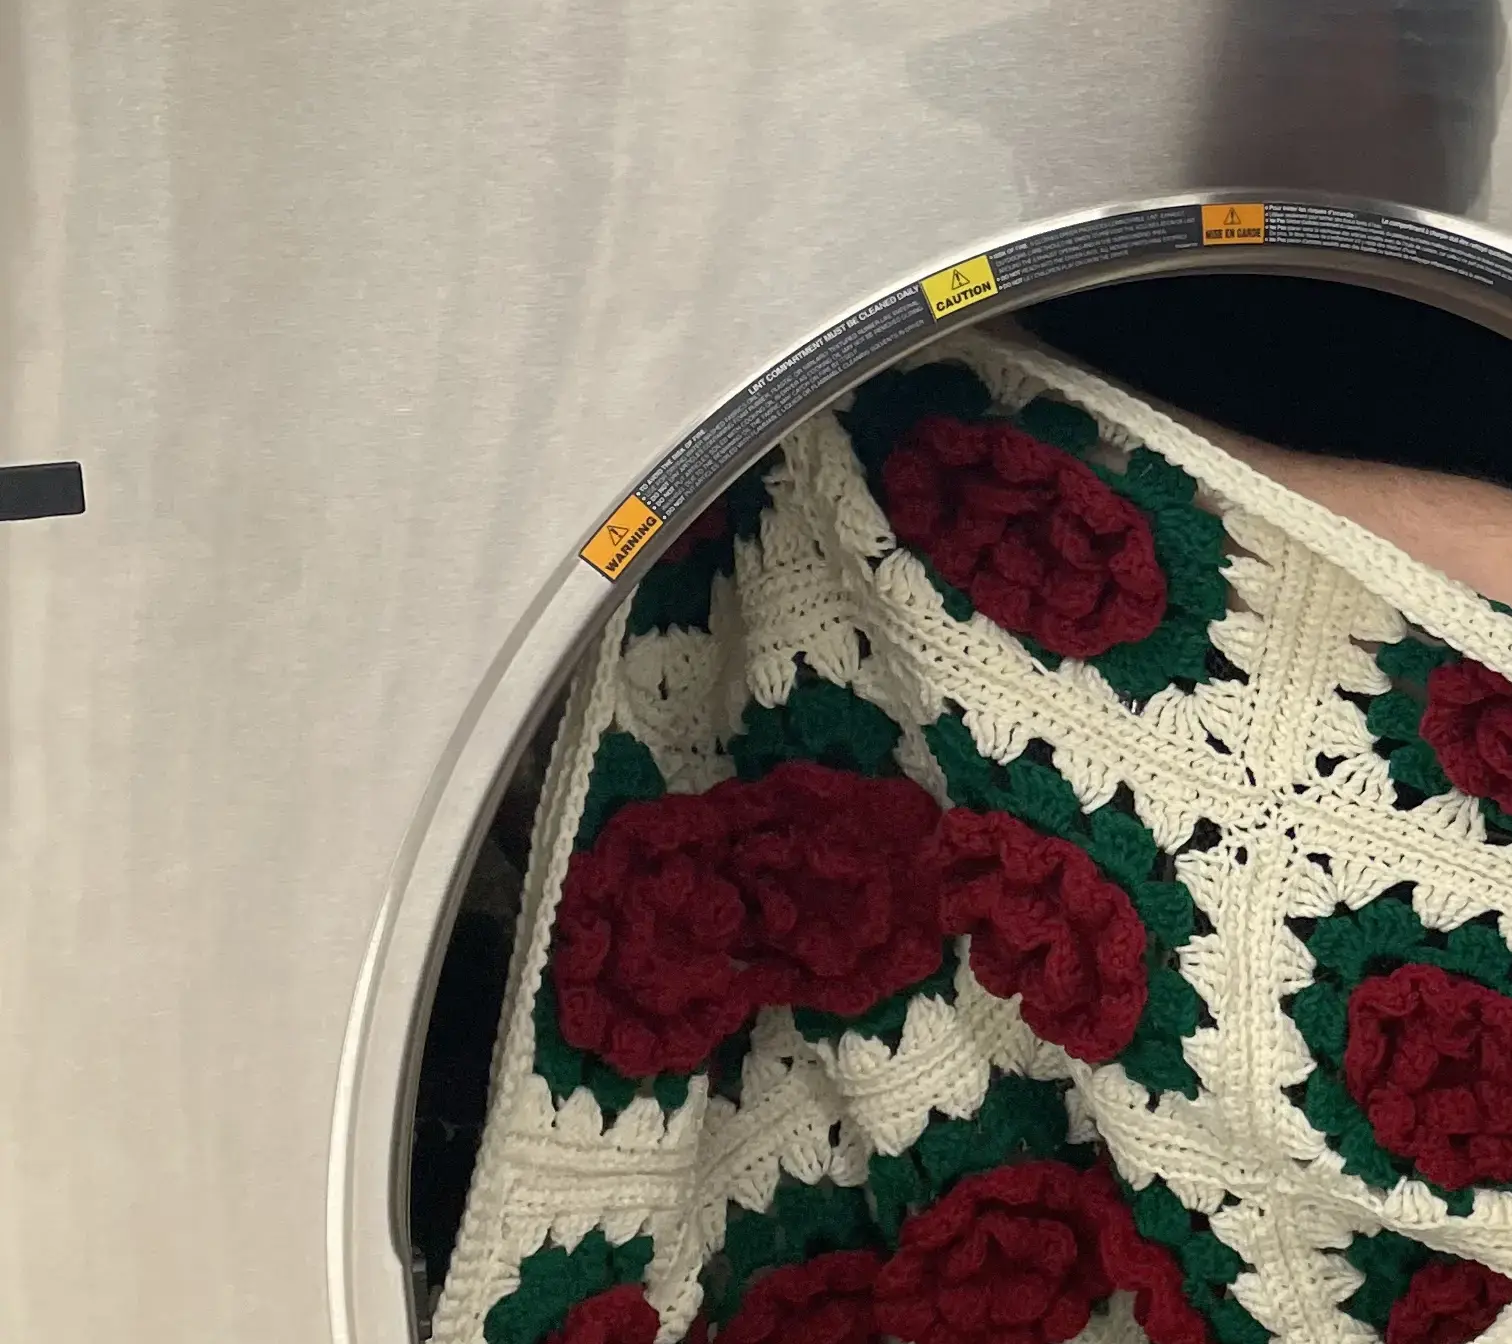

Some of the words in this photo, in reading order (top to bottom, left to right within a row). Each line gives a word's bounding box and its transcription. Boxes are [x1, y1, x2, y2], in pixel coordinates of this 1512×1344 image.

[935, 280, 992, 313] CAUTION
[746, 376, 768, 395] LINT
[763, 336, 826, 383] COMPARTMENT
[822, 322, 848, 342] MUST
[856, 295, 898, 322] CLEANED
[895, 284, 921, 301] DAILY
[604, 515, 657, 575] WARNING
